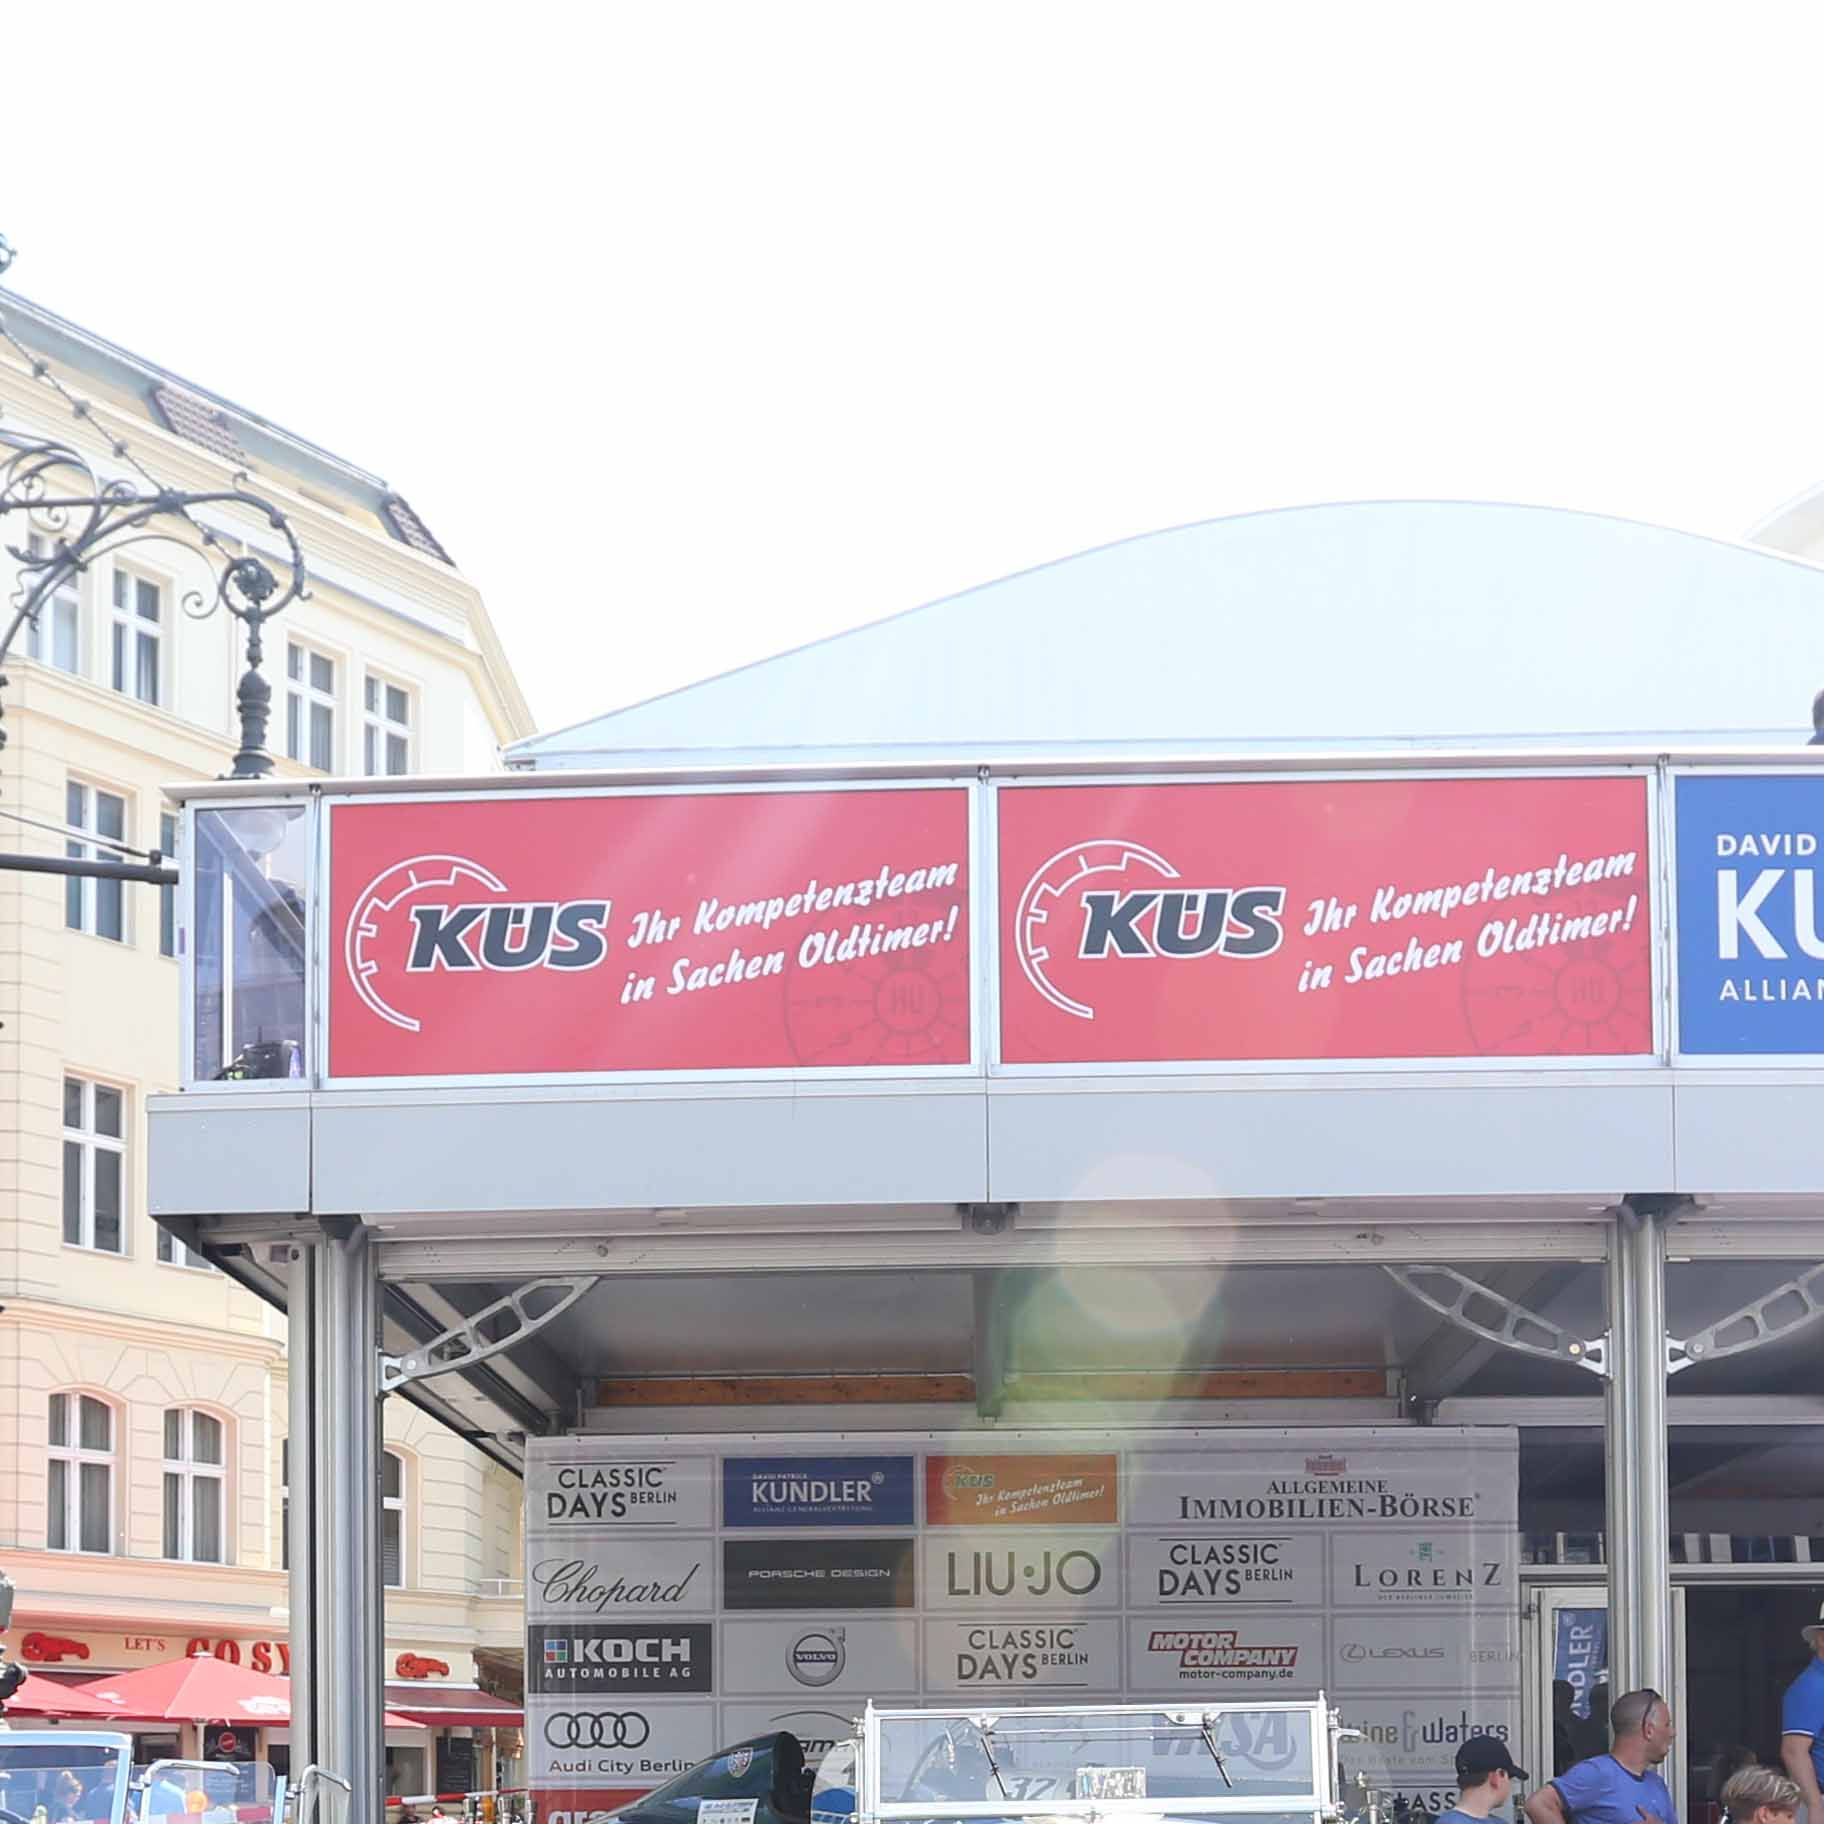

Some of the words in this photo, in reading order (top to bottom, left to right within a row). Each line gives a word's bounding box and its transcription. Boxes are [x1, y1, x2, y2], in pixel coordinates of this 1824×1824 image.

[1716, 834, 1817, 857] DAVID
[627, 910, 682, 948] Ihr
[692, 862, 958, 936] Kompetenzteam
[1303, 899, 1357, 936] Ihr
[1369, 852, 1637, 925] Kompetenzteam
[1078, 886, 1287, 959] KÜS
[406, 900, 611, 973] KÜS
[1297, 959, 1332, 993] in
[1344, 937, 1464, 986] Sachen
[1476, 895, 1639, 959] Oldtimer!
[620, 971, 655, 1005] in
[667, 948, 785, 996] Sachen
[798, 905, 959, 969] Oldtimer!
[559, 1467, 663, 1490] CLASSIC
[1266, 1480, 1388, 1494] ALLGEMEINE
[752, 1481, 872, 1503] KUNDLER
[548, 1493, 626, 1518] DAYS
[630, 1491, 676, 1504] BERLIN
[1179, 1493, 1474, 1520] IMMOBILIEN-BÖRSE
[1170, 1544, 1279, 1566] CLASSIC
[748, 1569, 826, 1579] PORSCHE
[831, 1568, 891, 1578] DESIGN
[1159, 1568, 1241, 1596] DAYS
[1245, 1567, 1293, 1582] BERLIN
[532, 1558, 701, 1613] Chopard
[125, 1637, 167, 1651] LET'S
[574, 1638, 690, 1663] KOCH
[969, 1629, 1074, 1650] CLASSIC
[1151, 1633, 1234, 1649] MOTOR
[796, 1653, 836, 1661] VOLVO
[1183, 1649, 1296, 1666] COMPANY
[1369, 1647, 1445, 1659] LEXUS
[545, 1667, 661, 1679] AUTOMOBILE
[670, 1667, 691, 1678] AG
[958, 1654, 1037, 1680] DAYS
[1041, 1653, 1088, 1665] BERLIN
[1179, 1669, 1293, 1681] motor-company.de
[1422, 1710, 1509, 1744] waters
[550, 1759, 593, 1772] Audi
[597, 1759, 635, 1776] City
[642, 1758, 695, 1773] Berlin
